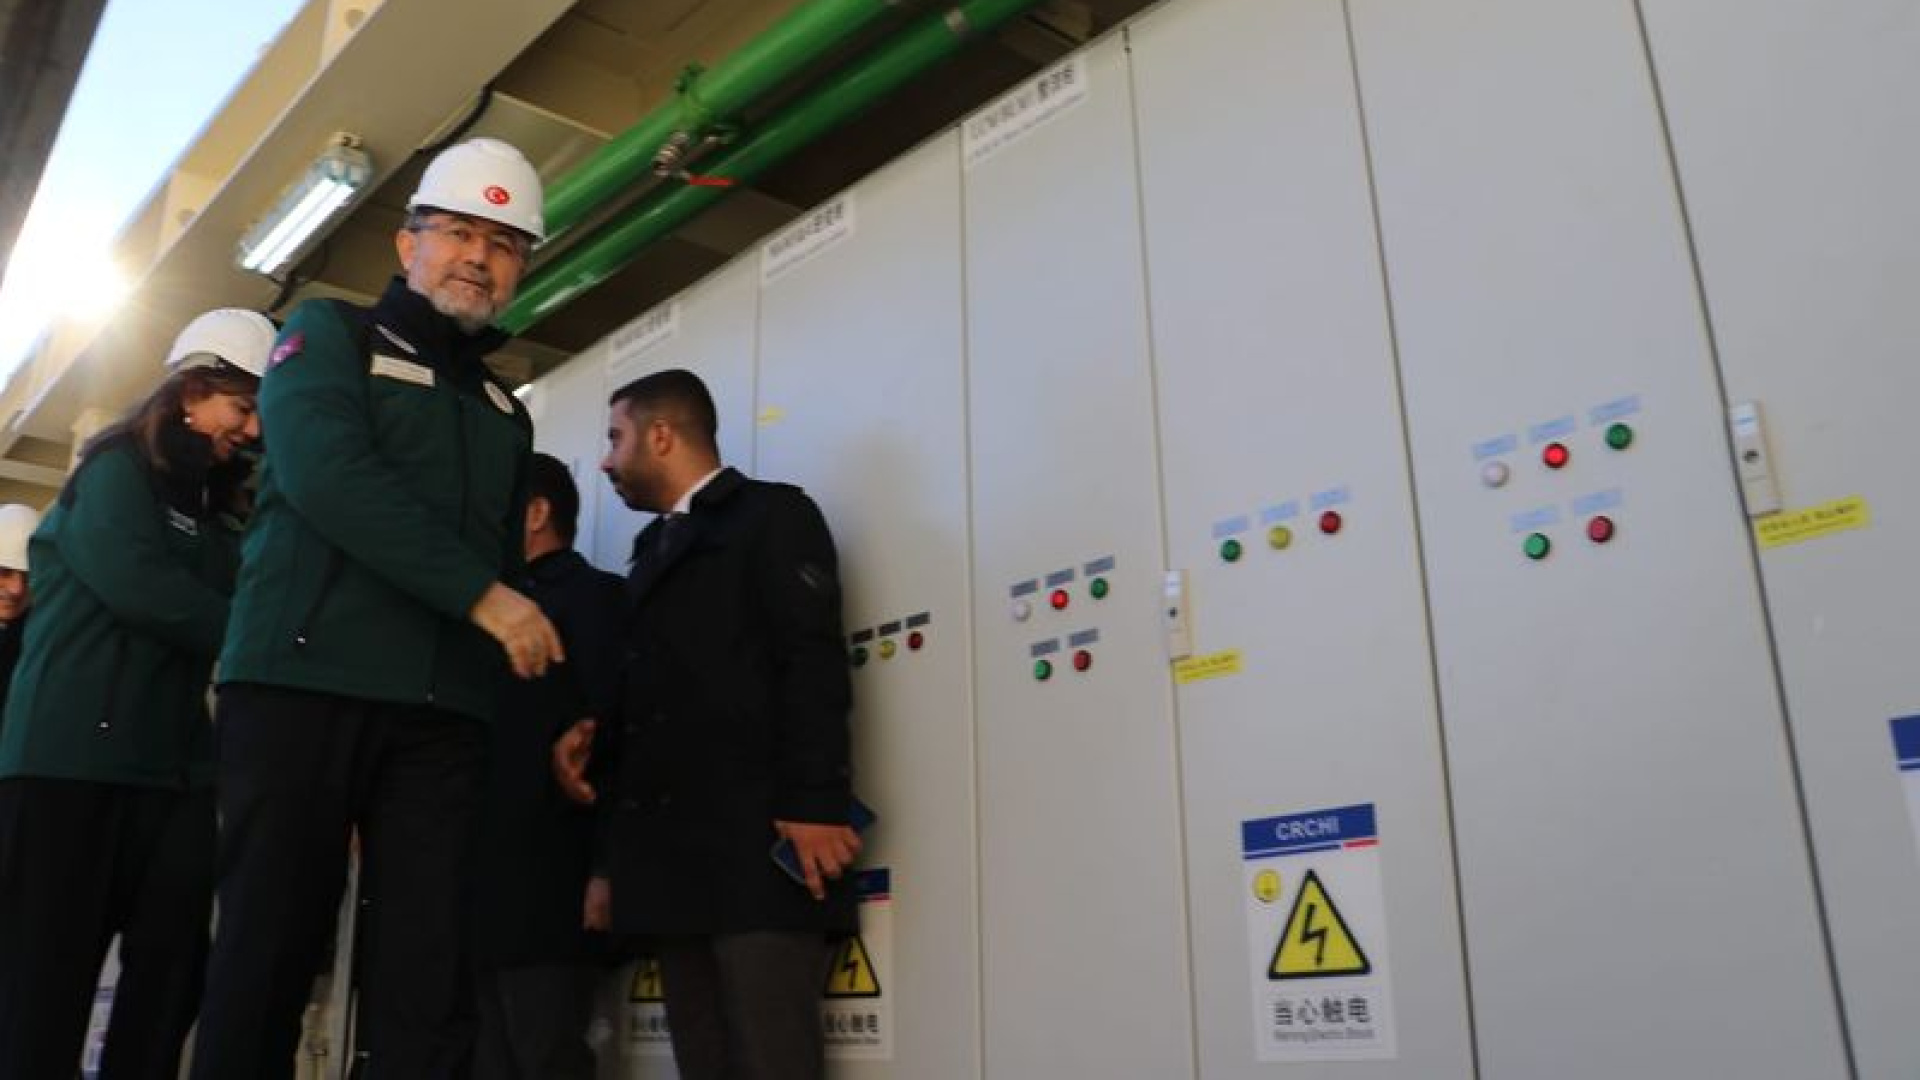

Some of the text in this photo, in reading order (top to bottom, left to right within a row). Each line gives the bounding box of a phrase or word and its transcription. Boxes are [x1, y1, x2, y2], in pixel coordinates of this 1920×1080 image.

[1275, 815, 1340, 841] CRCHI
[1274, 997, 1371, 1025] 当心触电
